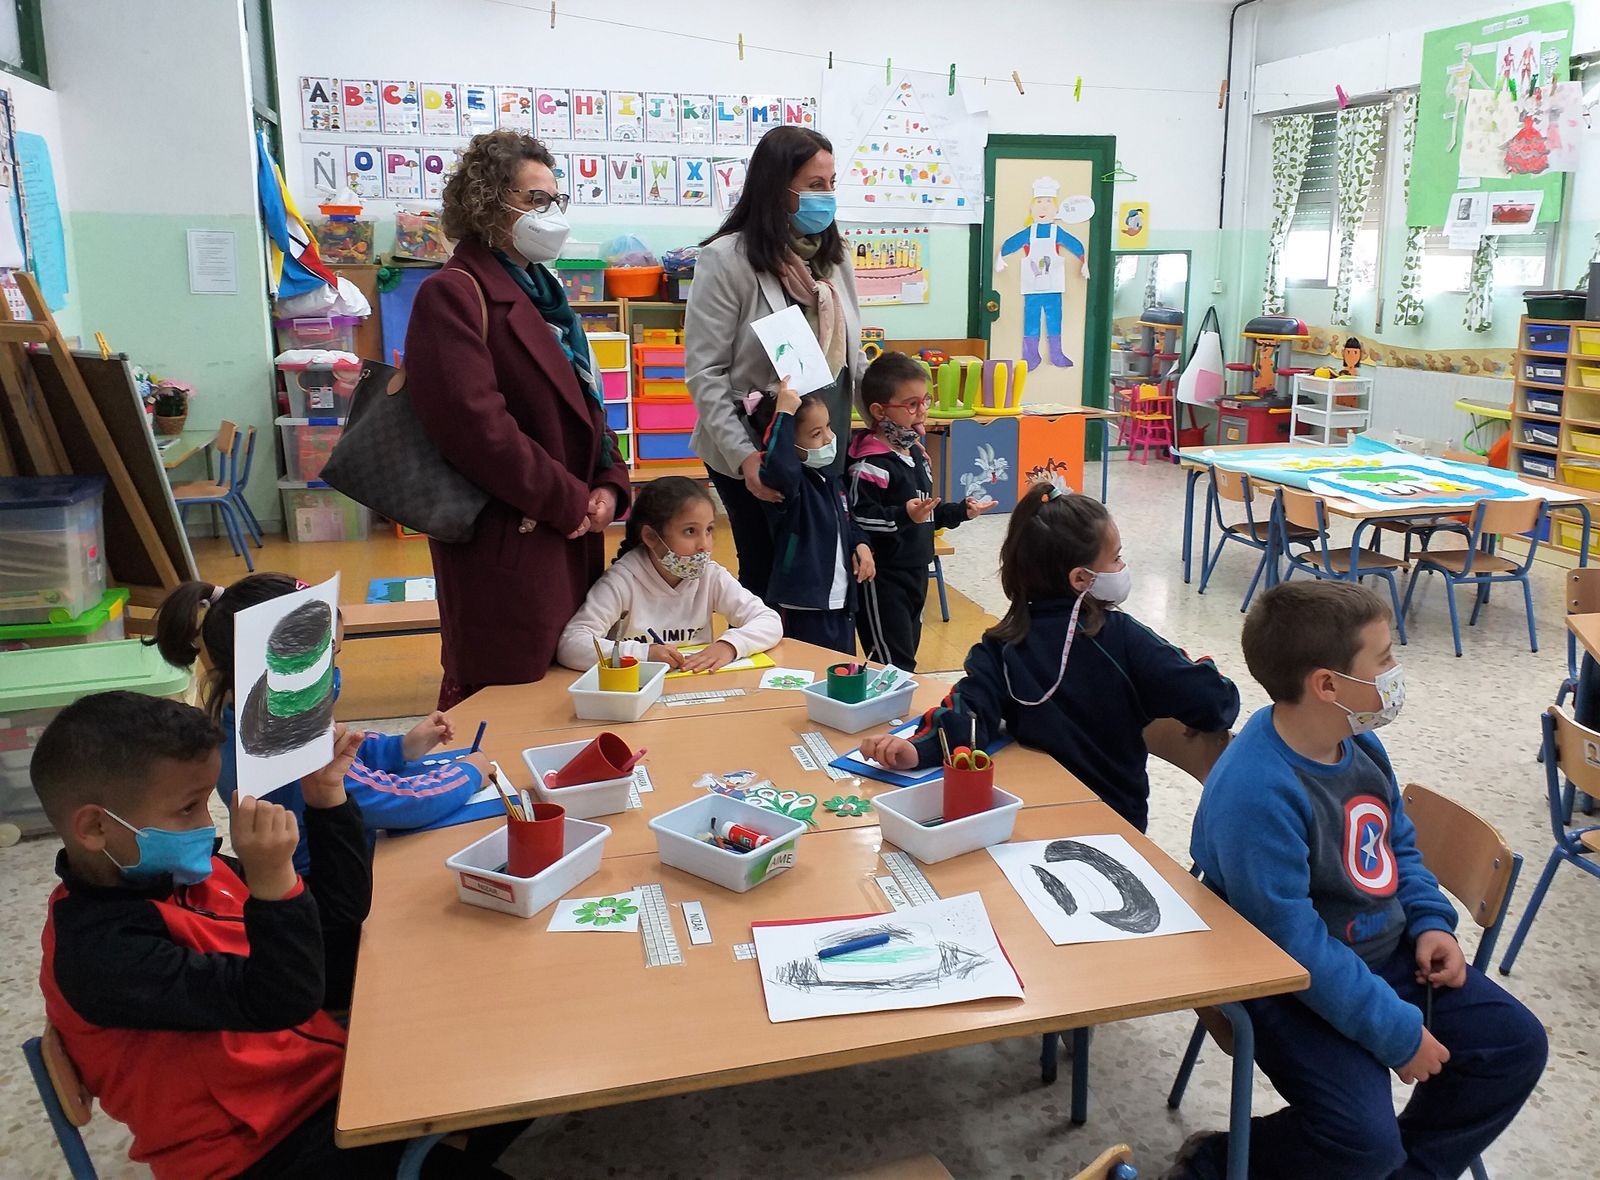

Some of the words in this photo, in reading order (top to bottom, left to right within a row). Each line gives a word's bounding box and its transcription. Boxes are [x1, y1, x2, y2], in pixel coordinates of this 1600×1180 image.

[309, 81, 330, 102] A
[344, 86, 364, 106] B
[383, 85, 401, 105] C
[423, 89, 442, 110] D
[467, 90, 486, 111] E
[501, 92, 519, 112] F
[538, 94, 556, 114] G
[576, 96, 593, 115] H
[618, 96, 636, 116] I
[650, 98, 665, 118] J
[718, 101, 734, 121] L
[752, 105, 768, 123] M
[786, 104, 802, 123] N
[314, 151, 336, 190] Ñ
[354, 151, 373, 171] O
[388, 154, 406, 174] P
[425, 154, 444, 175] Q
[580, 159, 597, 178] U
[610, 160, 628, 180] V
[652, 159, 668, 180] W
[687, 161, 704, 181] X
[718, 167, 734, 188] Y
[689, 913, 705, 933] NIZAR
